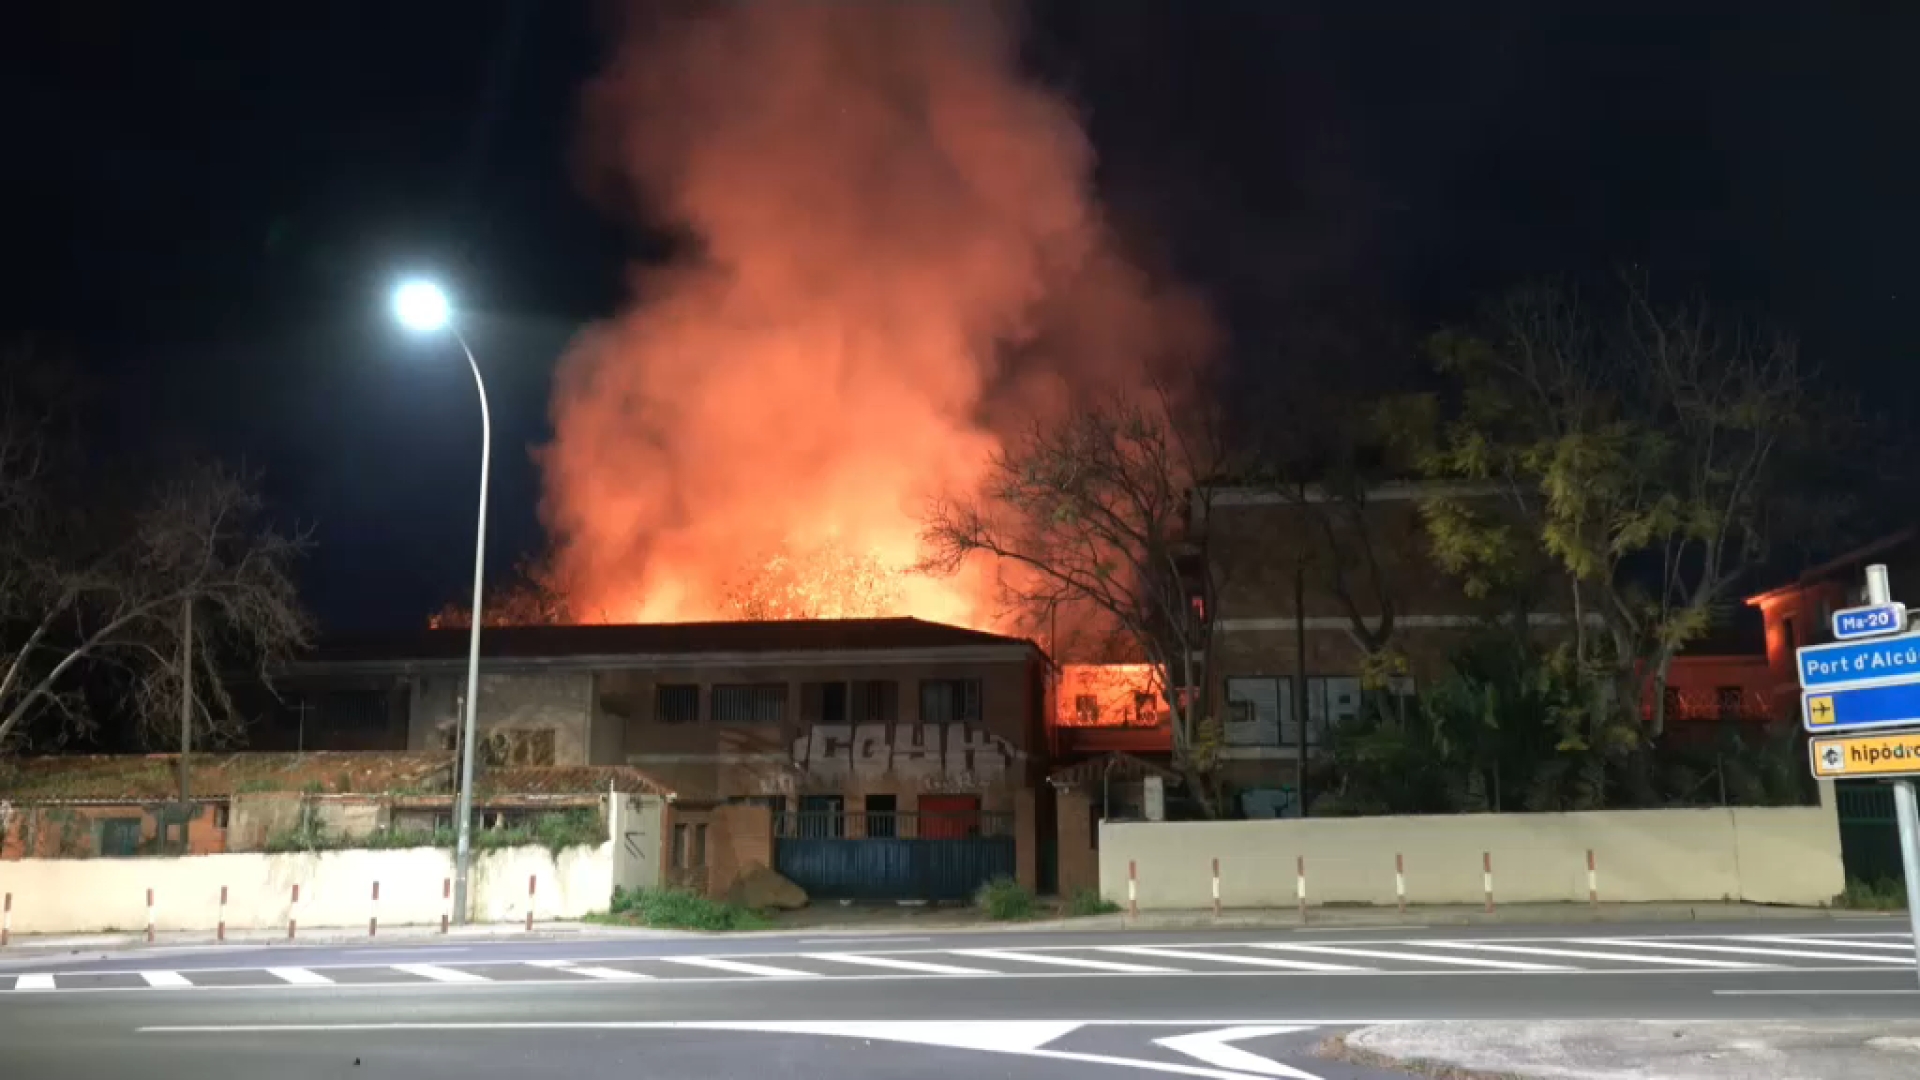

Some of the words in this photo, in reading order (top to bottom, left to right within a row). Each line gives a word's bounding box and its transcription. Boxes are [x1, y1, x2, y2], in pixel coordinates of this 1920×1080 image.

[1843, 611, 1889, 630] Ma-20
[1807, 655, 1849, 675] Port
[1855, 647, 1920, 671] d'Alcú
